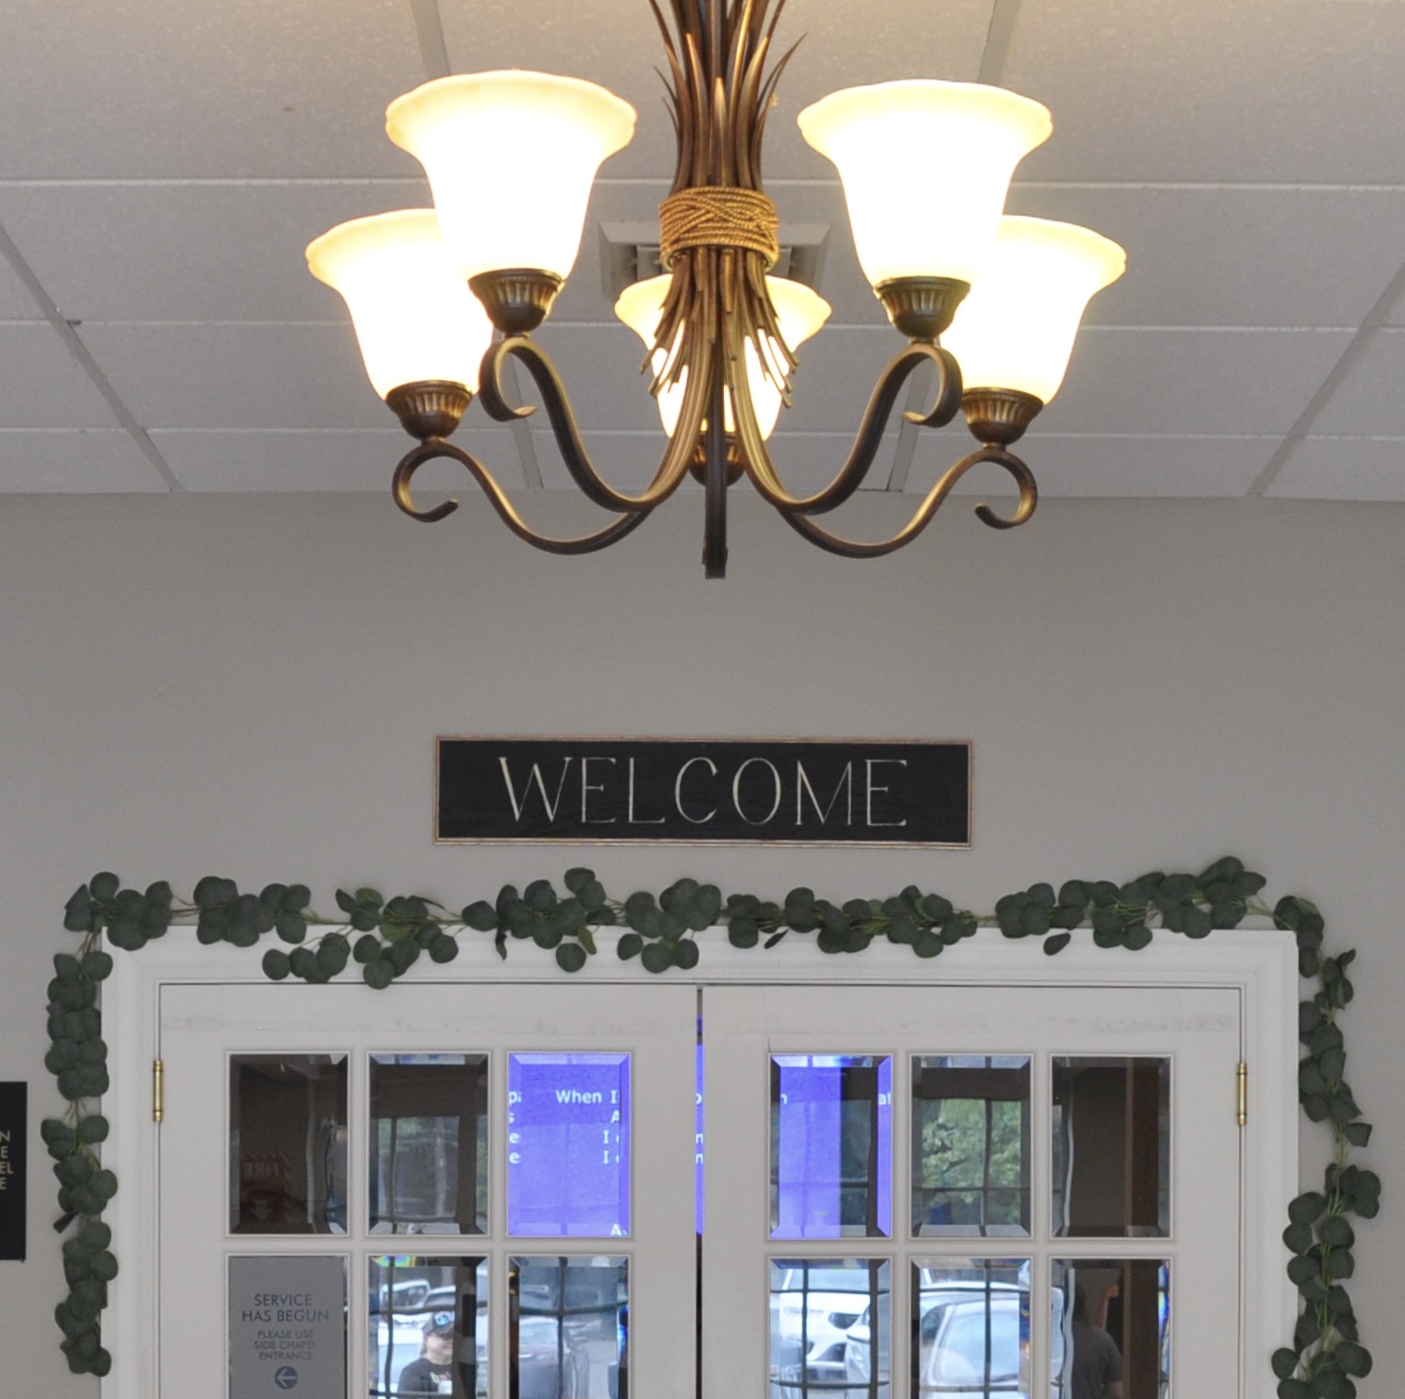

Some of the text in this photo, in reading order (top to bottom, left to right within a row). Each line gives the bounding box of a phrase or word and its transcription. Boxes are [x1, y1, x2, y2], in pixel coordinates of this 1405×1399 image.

[498, 756, 908, 828] WELCOME
[555, 1089, 603, 1104] When
[254, 1294, 313, 1306] SERVICE
[242, 1309, 329, 1322] HAS BEGUN
[257, 1330, 314, 1339] PLEASE USE
[254, 1340, 317, 1350] SIDE CHAPEL
[259, 1351, 313, 1361] ENTRANCE
